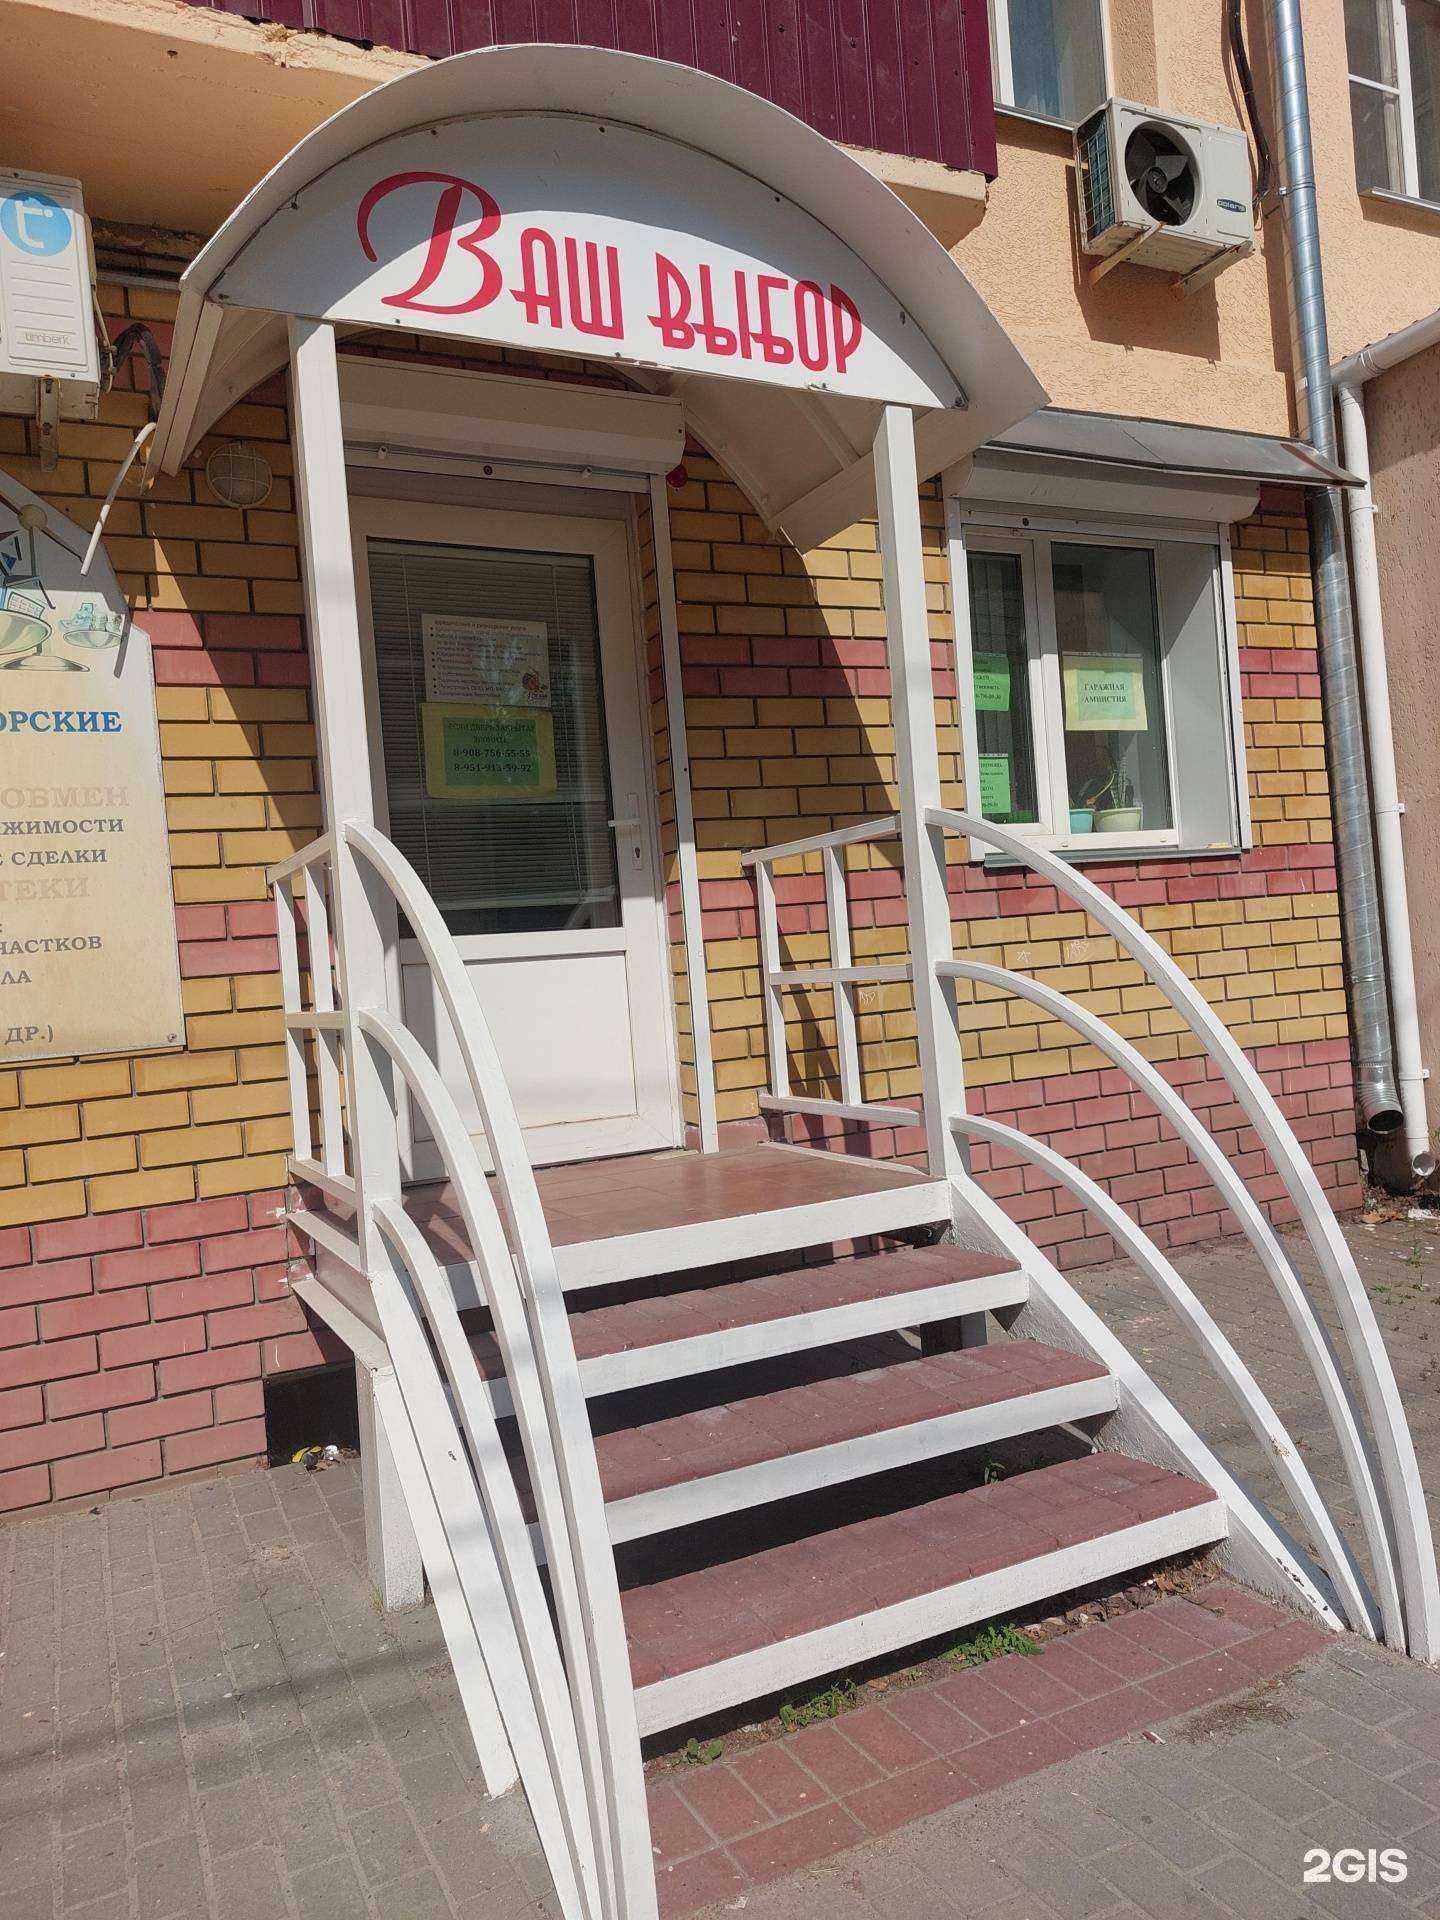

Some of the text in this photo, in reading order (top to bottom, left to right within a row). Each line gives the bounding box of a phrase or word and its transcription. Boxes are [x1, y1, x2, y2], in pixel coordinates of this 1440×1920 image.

[647, 252, 862, 374] ВЫБОР
[1, 786, 130, 809] ОБМЕН
[0, 819, 124, 836] ЖИМОСТИ
[11, 849, 107, 867] СДЕЛКИ
